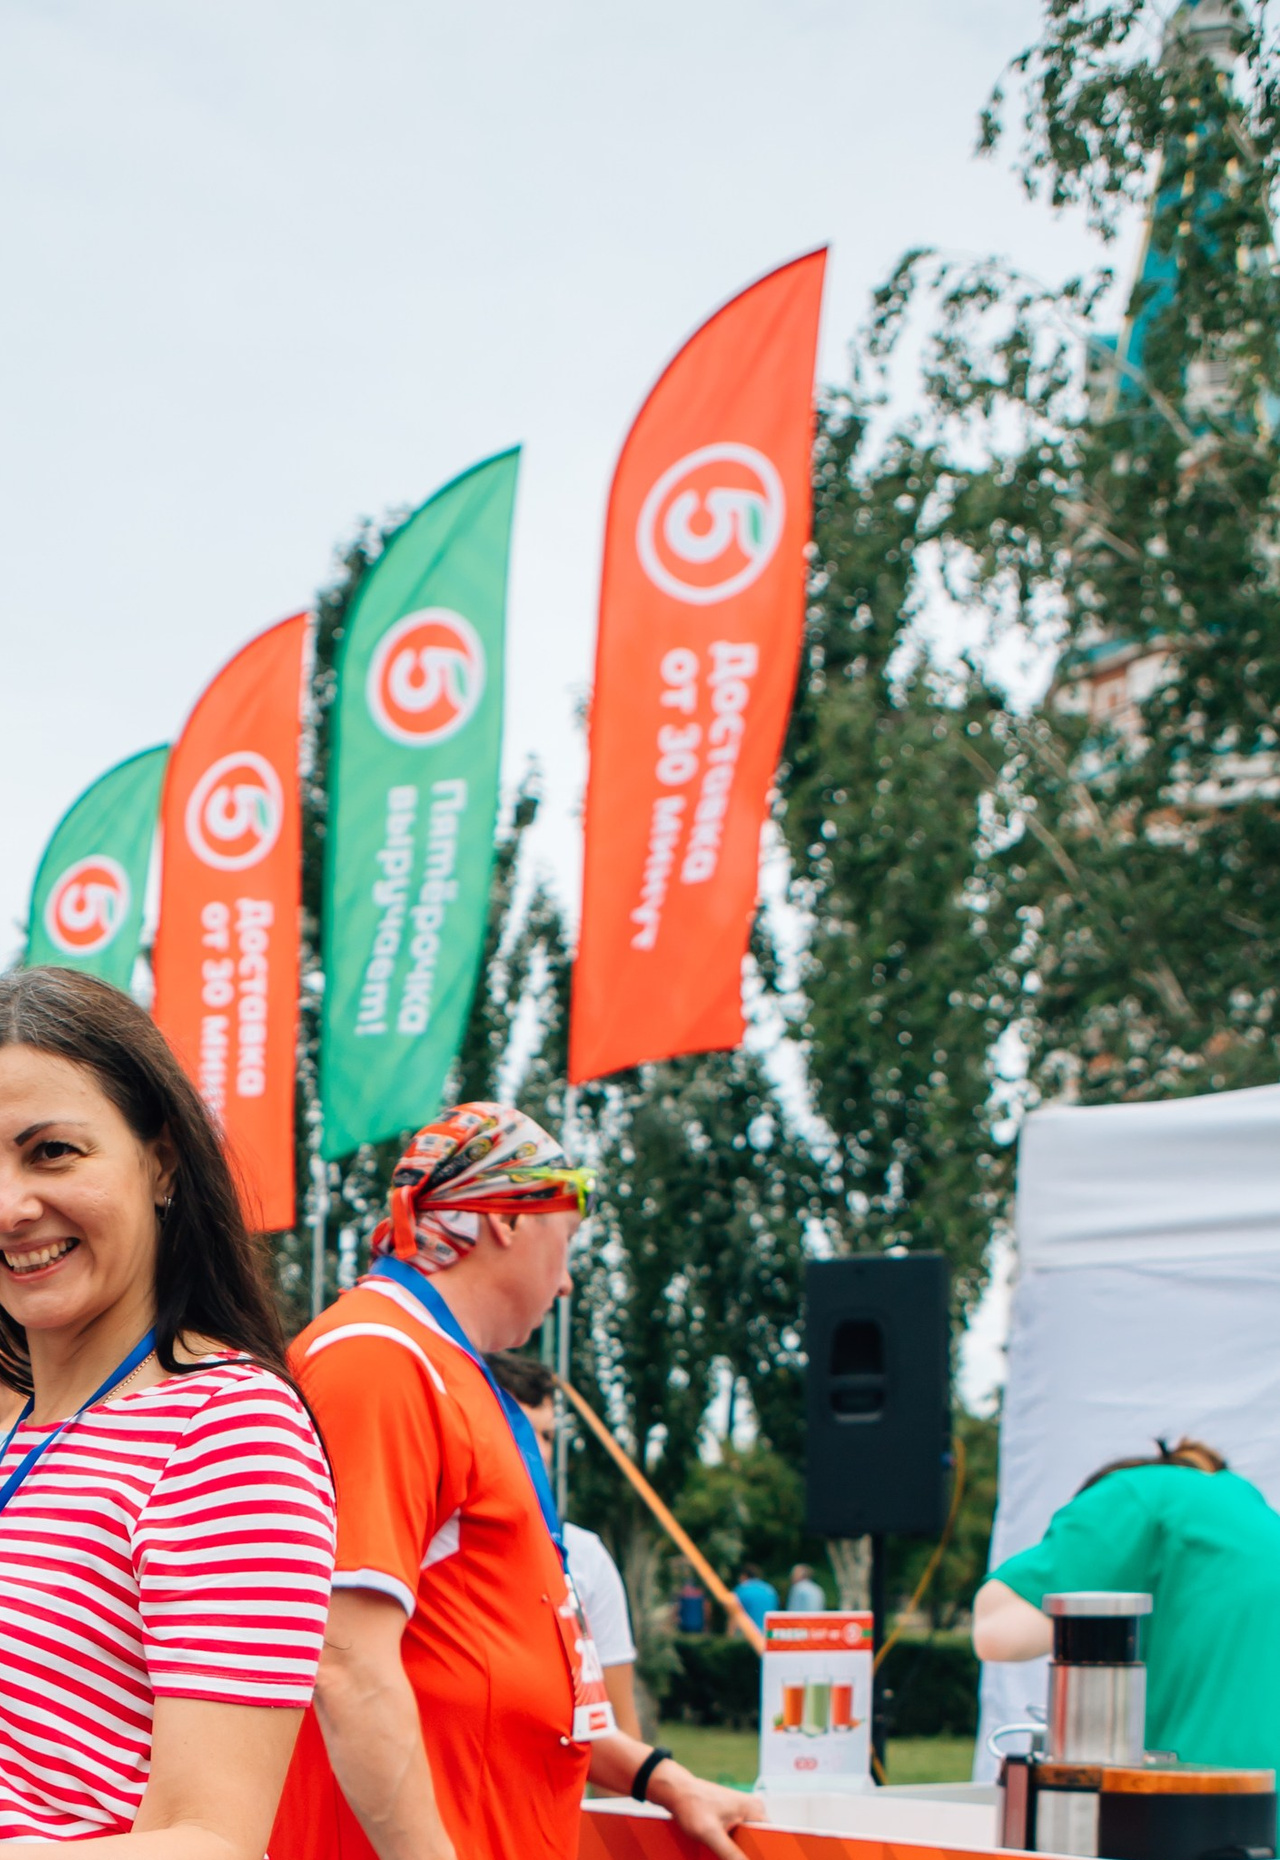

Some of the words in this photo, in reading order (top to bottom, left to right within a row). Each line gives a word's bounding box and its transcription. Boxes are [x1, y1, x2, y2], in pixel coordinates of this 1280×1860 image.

[660, 647, 700, 714] от
[654, 722, 702, 786] 30
[680, 639, 759, 884] Доставка
[200, 901, 231, 951] от
[353, 784, 418, 1038] выручает!
[396, 778, 468, 1036] Пятёрочка
[201, 957, 234, 1008] 30
[235, 898, 275, 1097] Доставка
